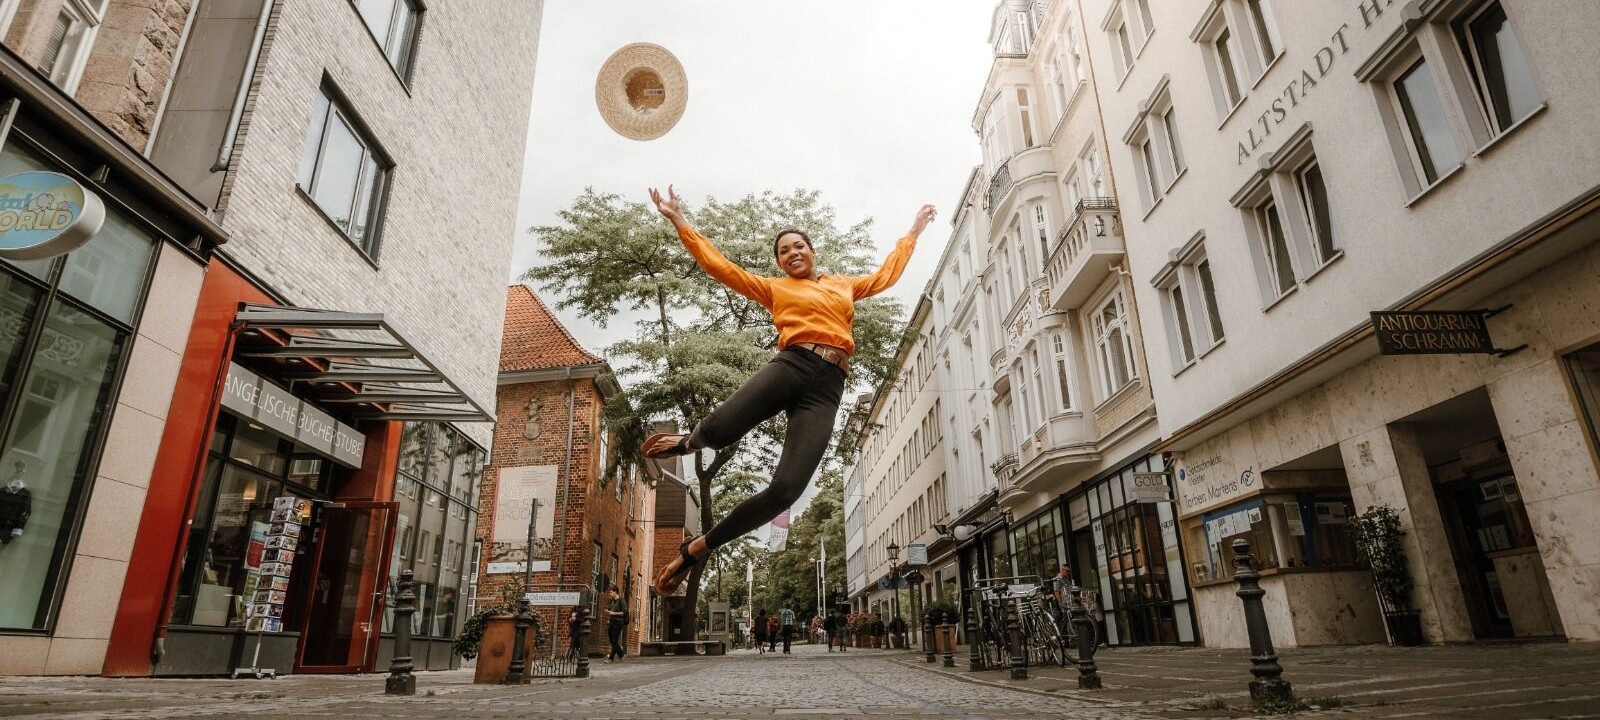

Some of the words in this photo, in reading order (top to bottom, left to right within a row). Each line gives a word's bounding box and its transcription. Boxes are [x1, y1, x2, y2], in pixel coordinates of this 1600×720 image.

[1238, 22, 1350, 166] ALTSTADT
[1357, 0, 1392, 29] H
[298, 412, 362, 457] BÜCHERSTUBE
[1134, 475, 1163, 487] GOLD
[1184, 493, 1207, 508] Torben
[1207, 481, 1238, 500] Martens
